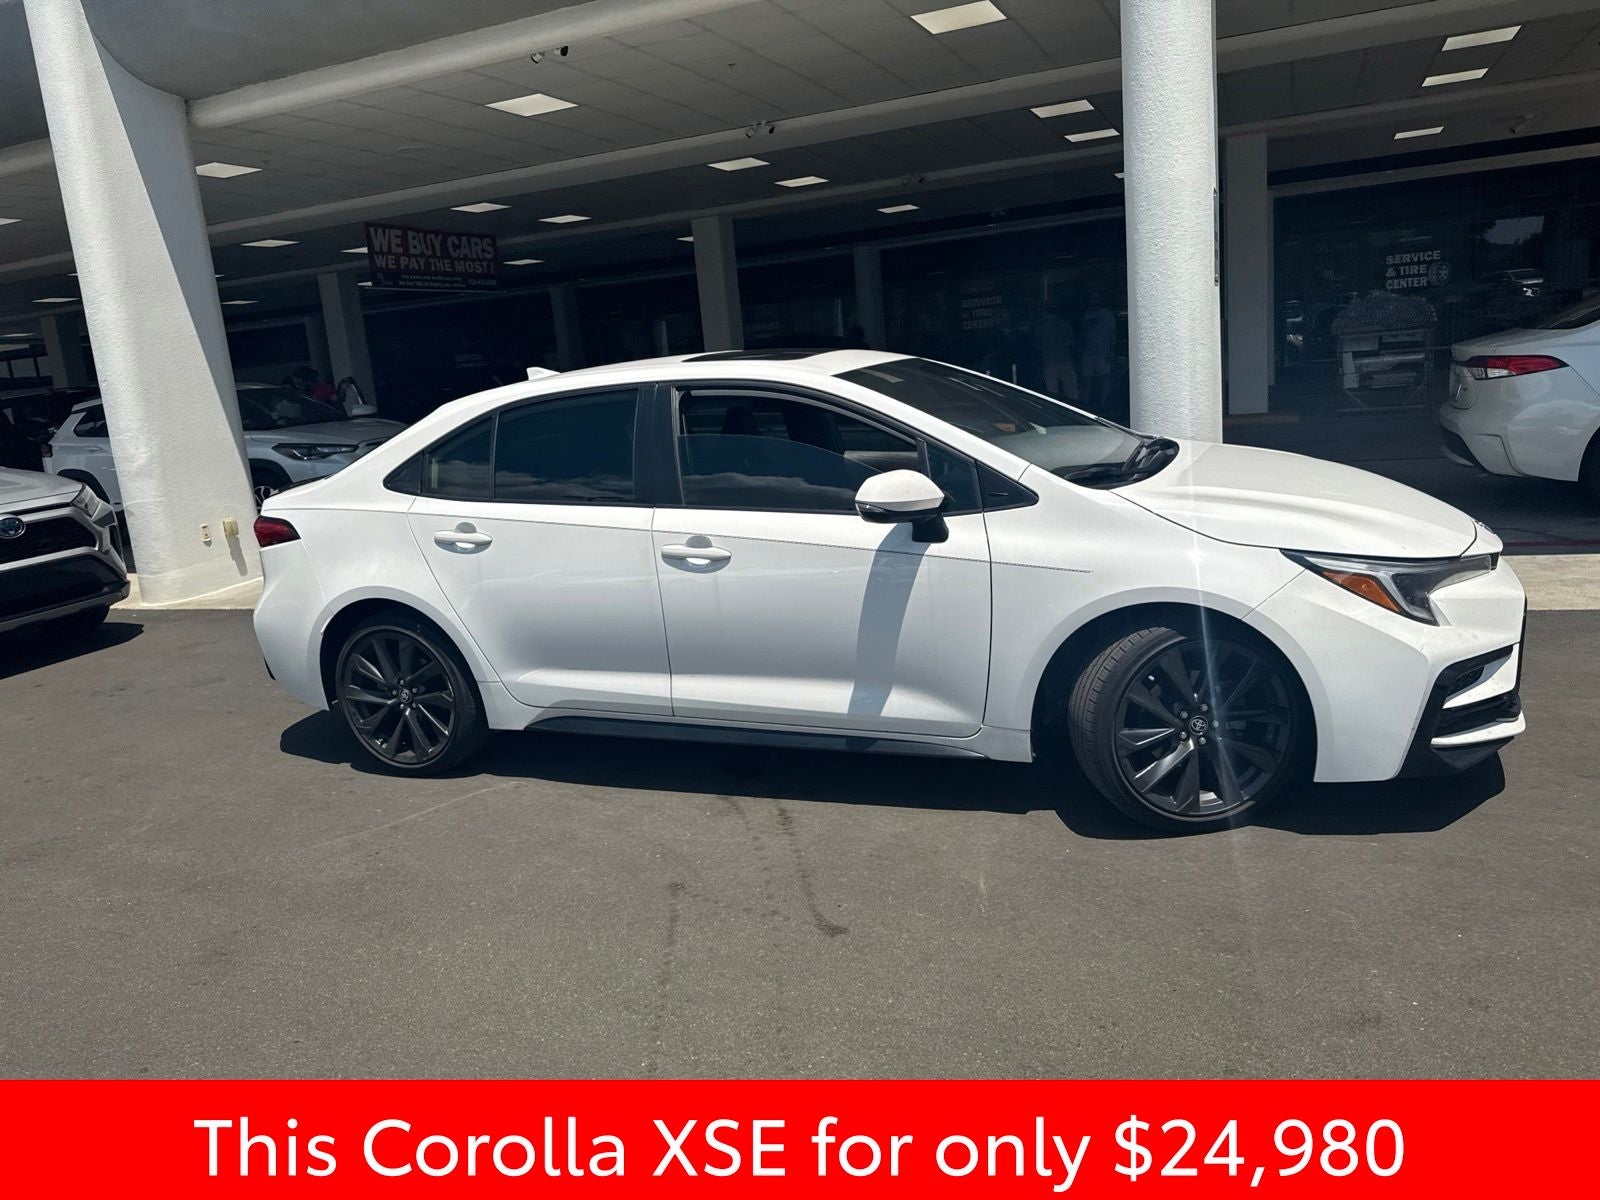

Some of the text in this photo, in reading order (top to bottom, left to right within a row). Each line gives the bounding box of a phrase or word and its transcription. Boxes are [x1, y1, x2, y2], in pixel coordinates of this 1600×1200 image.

[369, 227, 494, 260] WE BUY CARS
[373, 254, 396, 268] WE
[400, 256, 425, 271] PAY
[429, 258, 452, 272] THE
[1386, 250, 1441, 264] SERVICE
[1399, 264, 1427, 276] TIRE
[1386, 276, 1428, 289] CENTER
